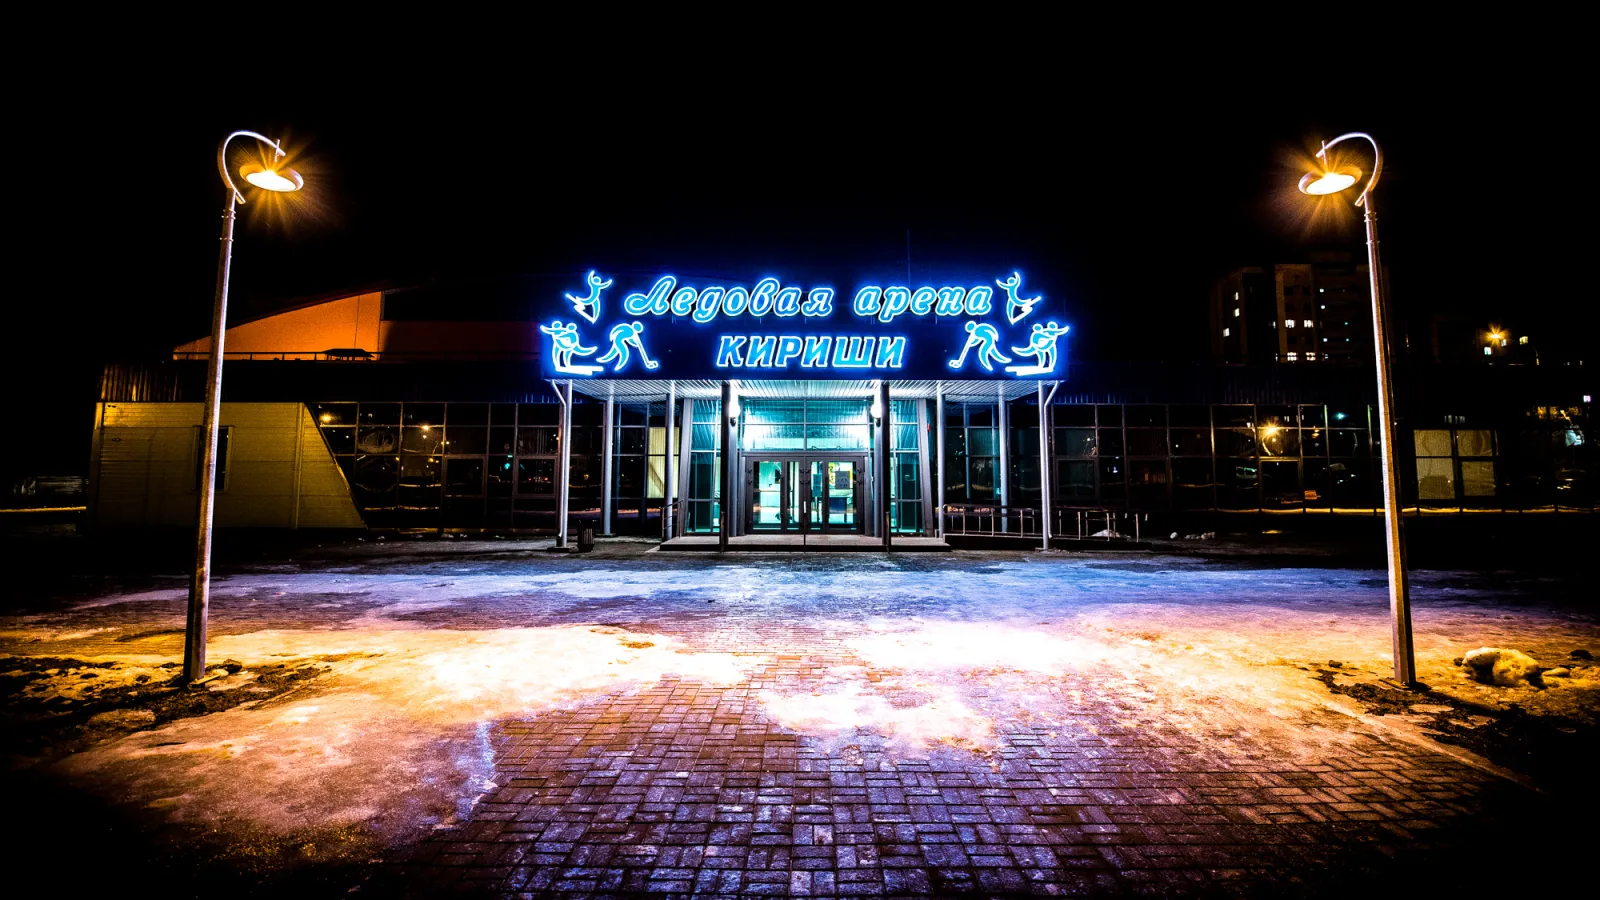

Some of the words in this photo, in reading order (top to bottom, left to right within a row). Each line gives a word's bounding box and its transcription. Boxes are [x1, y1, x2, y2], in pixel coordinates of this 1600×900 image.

[624, 275, 833, 323] Ледовая
[853, 285, 993, 322] арена
[716, 335, 906, 369] КИРИШИ
